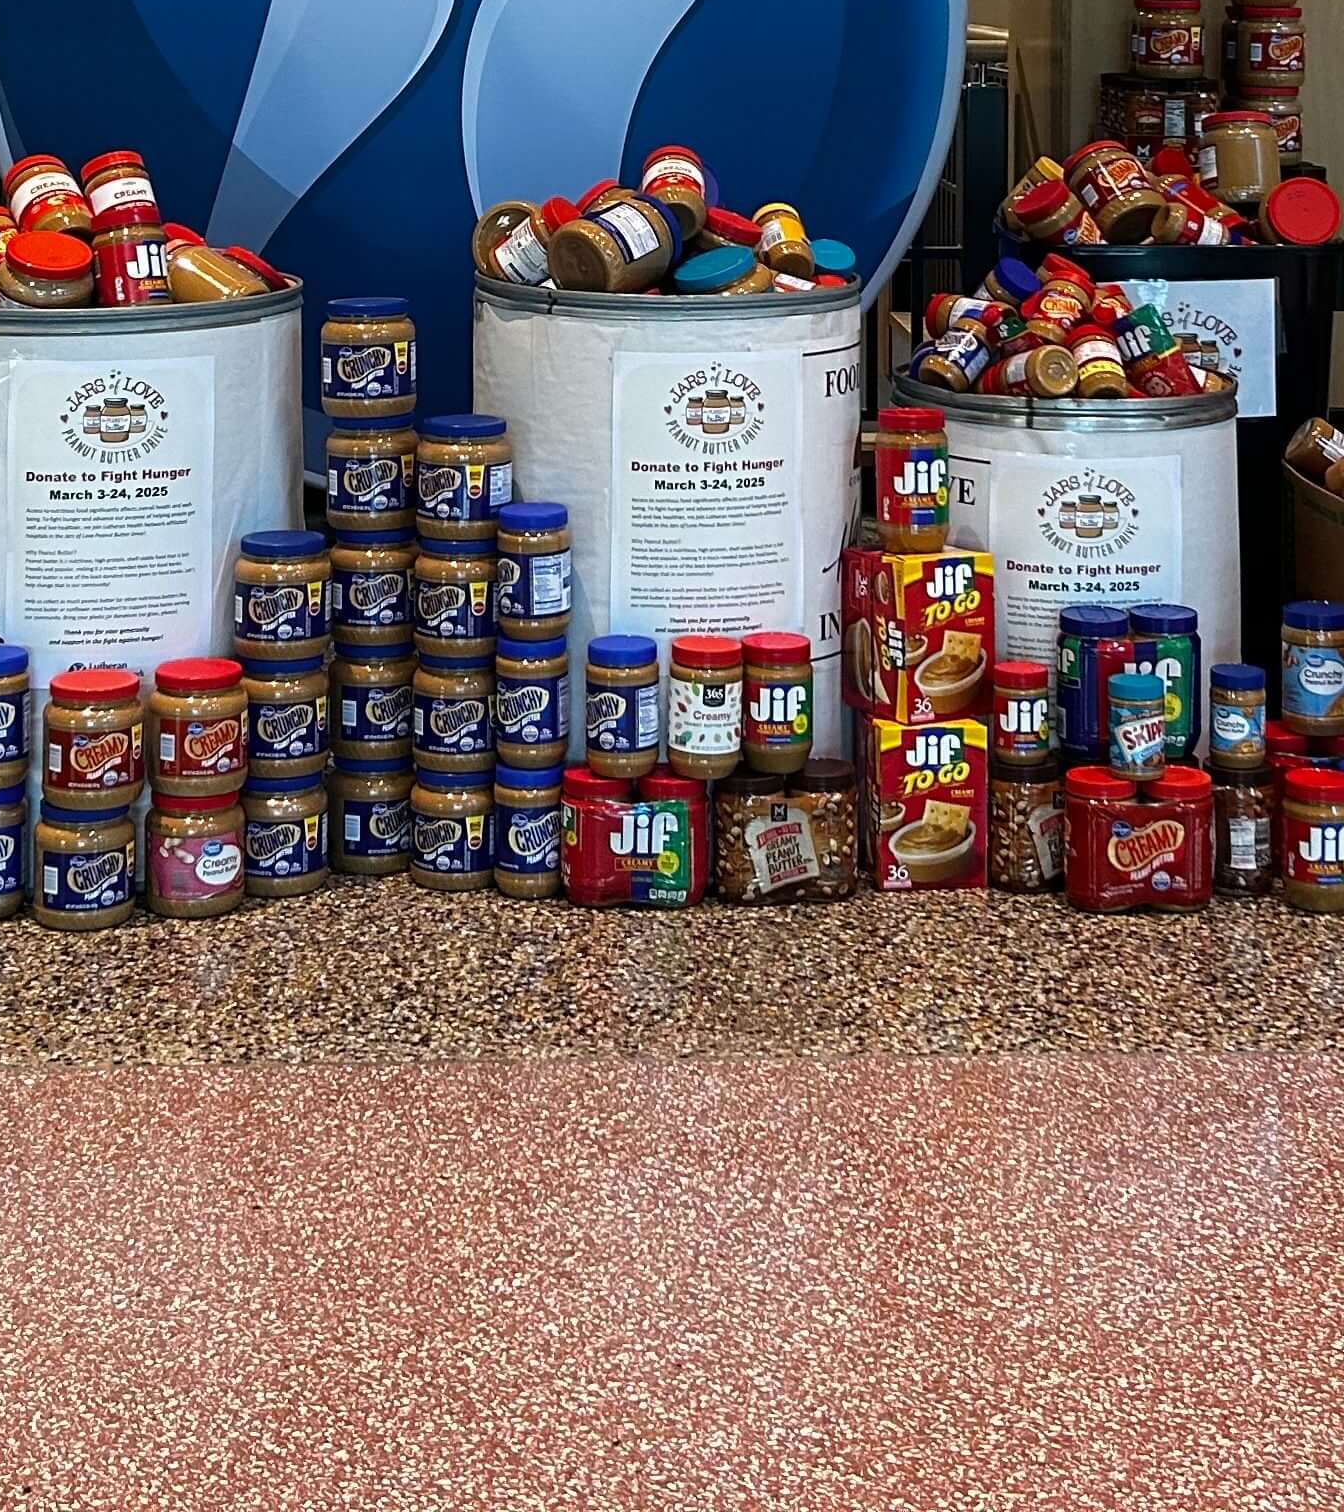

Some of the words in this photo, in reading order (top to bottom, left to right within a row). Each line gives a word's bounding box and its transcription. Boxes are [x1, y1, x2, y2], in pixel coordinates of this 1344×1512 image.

[29, 179, 71, 196] CREAMY
[113, 189, 149, 200] CREAMY
[1194, 312, 1239, 345] LOVE
[342, 349, 387, 380] CRUNCHY
[68, 378, 106, 412] JARS
[122, 377, 164, 410] LOVE
[671, 370, 707, 404] JARS
[723, 369, 761, 400] LOVE
[62, 429, 98, 461] PEANUT
[100, 448, 142, 464] BUTTER
[145, 425, 168, 454] DRIVE
[666, 419, 700, 451] PEANUT
[702, 438, 740, 455] BUTTER
[744, 416, 765, 445] DRIVE
[26, 470, 77, 482] Donate
[82, 472, 96, 482] to
[101, 470, 138, 483] Fight
[142, 467, 191, 480] Hunger
[631, 461, 680, 473] Donate
[686, 462, 699, 473] to
[703, 461, 738, 474] Fight
[742, 458, 784, 472] Hunger
[893, 459, 947, 495] Jif
[50, 490, 92, 500] March
[97, 489, 131, 500] 3-24,
[136, 487, 168, 498] 2025
[655, 479, 696, 490] March
[700, 479, 731, 490] 3-24,
[736, 477, 765, 488] 2025
[1043, 475, 1081, 507] JARS
[1097, 474, 1136, 506] LOVE
[1038, 521, 1074, 554] PEANUT
[1076, 542, 1115, 560] BUTTER
[1117, 521, 1140, 549] DRIVE
[926, 563, 973, 598] Jif
[1006, 560, 1053, 575] Donate
[1058, 562, 1072, 575] to
[1077, 563, 1111, 576] Fight
[1115, 562, 1161, 575] Hunger
[1029, 579, 1069, 592] March
[1074, 582, 1106, 593] 3-24,
[1110, 581, 1140, 592] 2025
[924, 602, 951, 626] TO
[954, 590, 981, 612] GO
[1304, 669, 1342, 681] Crunchy
[705, 688, 724, 699] 365
[750, 686, 806, 722] Jif
[914, 697, 932, 713] 36
[693, 709, 732, 722] Creamy
[1000, 699, 1047, 732] Jif
[74, 736, 126, 770] CREAMY
[906, 735, 961, 766] Jif
[903, 770, 933, 794] TO
[938, 762, 969, 784] GO
[609, 812, 679, 855] Jif
[1114, 823, 1181, 862] CREAMY
[202, 854, 238, 868] Creamy
[766, 843, 802, 864] PEANUT
[768, 855, 804, 875] BUTTER
[74, 855, 124, 892] CRUNCHY
[888, 865, 907, 880] 36
